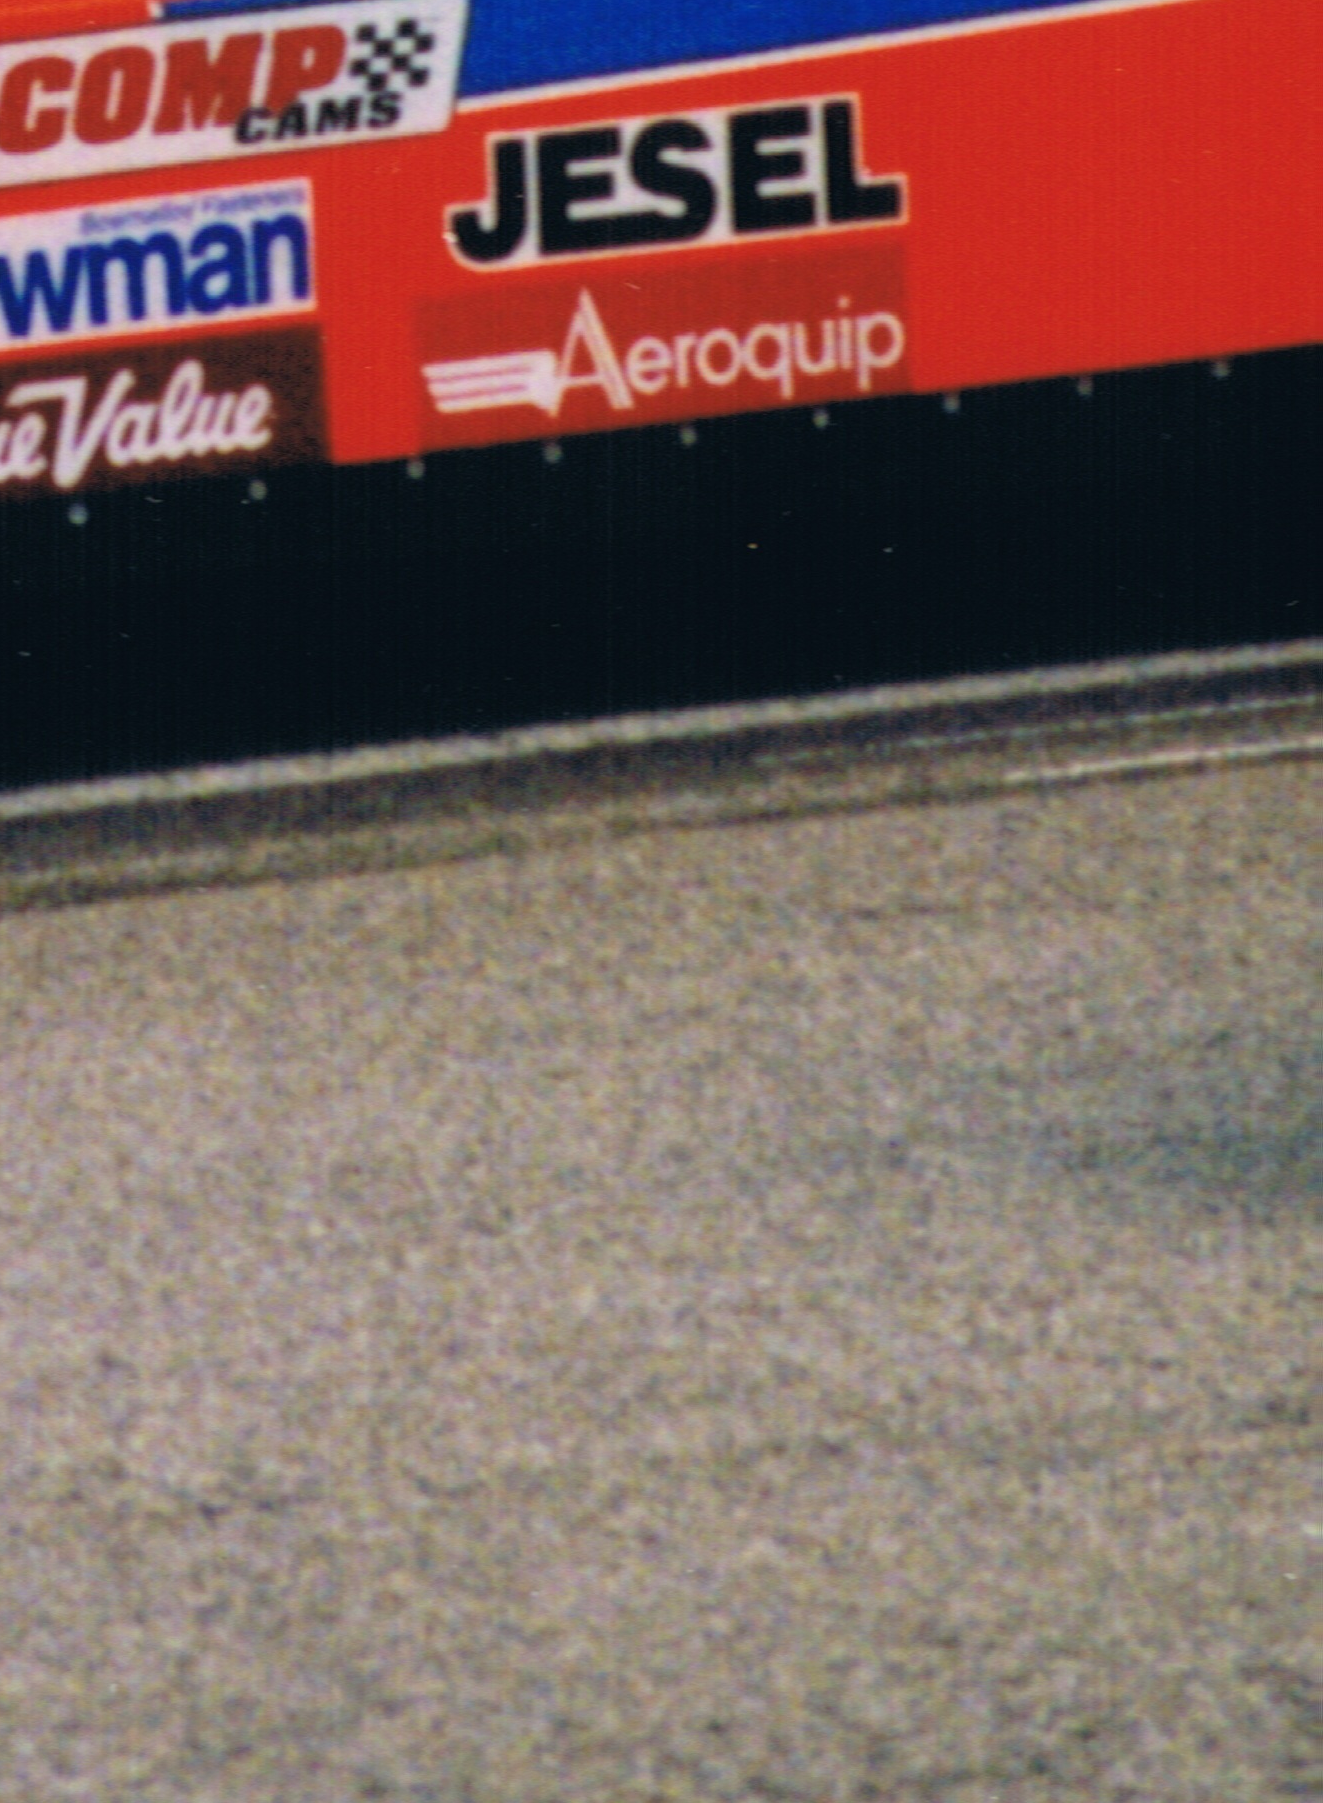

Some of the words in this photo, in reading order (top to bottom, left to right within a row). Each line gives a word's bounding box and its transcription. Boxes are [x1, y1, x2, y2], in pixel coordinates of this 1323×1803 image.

[234, 91, 402, 146] CAMS
[448, 96, 904, 266] JESEL
[551, 287, 906, 416] Aeroquip
